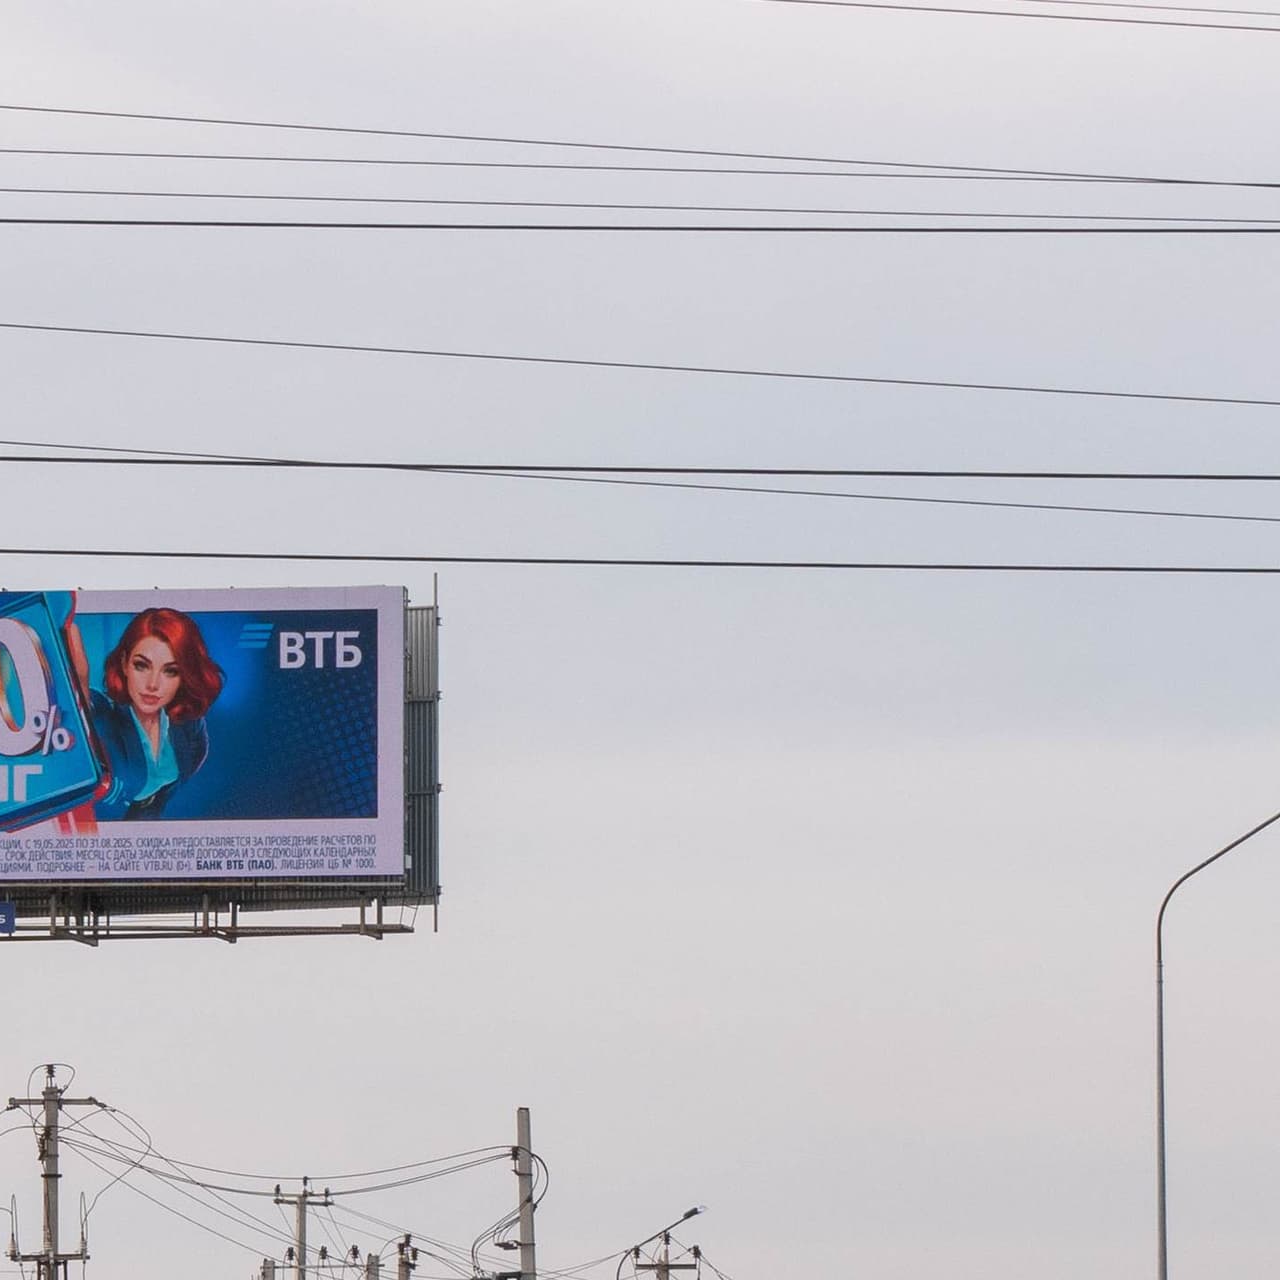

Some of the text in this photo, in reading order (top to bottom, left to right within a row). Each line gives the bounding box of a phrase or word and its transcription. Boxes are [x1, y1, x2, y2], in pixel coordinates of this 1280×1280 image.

[280, 631, 363, 669] ВТБ
[24, 838, 30, 849] С
[76, 838, 88, 848] ПО
[136, 837, 170, 847] СКИДКА
[172, 836, 250, 847] ПРЕДОСТАВЛЯЕТСЯ
[251, 836, 264, 846] ЗА
[264, 835, 318, 846] ПРОВЕДЕНИЕ
[320, 834, 362, 845] РАСЧЕТОВ
[364, 834, 376, 845] ПО
[4, 850, 26, 861] СРОК
[76, 849, 104, 860] МЕСЯЦ
[106, 849, 112, 859] С
[112, 849, 136, 859] ДАТЫ
[138, 848, 194, 859] ЗАКЛЮЧЕНИЯ
[196, 848, 240, 858] ДОГОВОРА
[242, 848, 248, 858] И
[250, 848, 255, 858] 3
[256, 847, 311, 858] СЛЕДУЮЩИХ
[313, 846, 376, 857] КАЛЕНДАРНЫХ
[36, 862, 84, 872] ПОДРОБНЕЕ
[98, 861, 110, 871] НА
[112, 860, 140, 871] САЙТЕ
[142, 861, 172, 871] VTB.RU
[196, 860, 222, 870] БАНК
[226, 860, 244, 870] ВТБ
[280, 859, 324, 869] ЛИЦЕНЗИЯ
[327, 859, 339, 869] ЦБ
